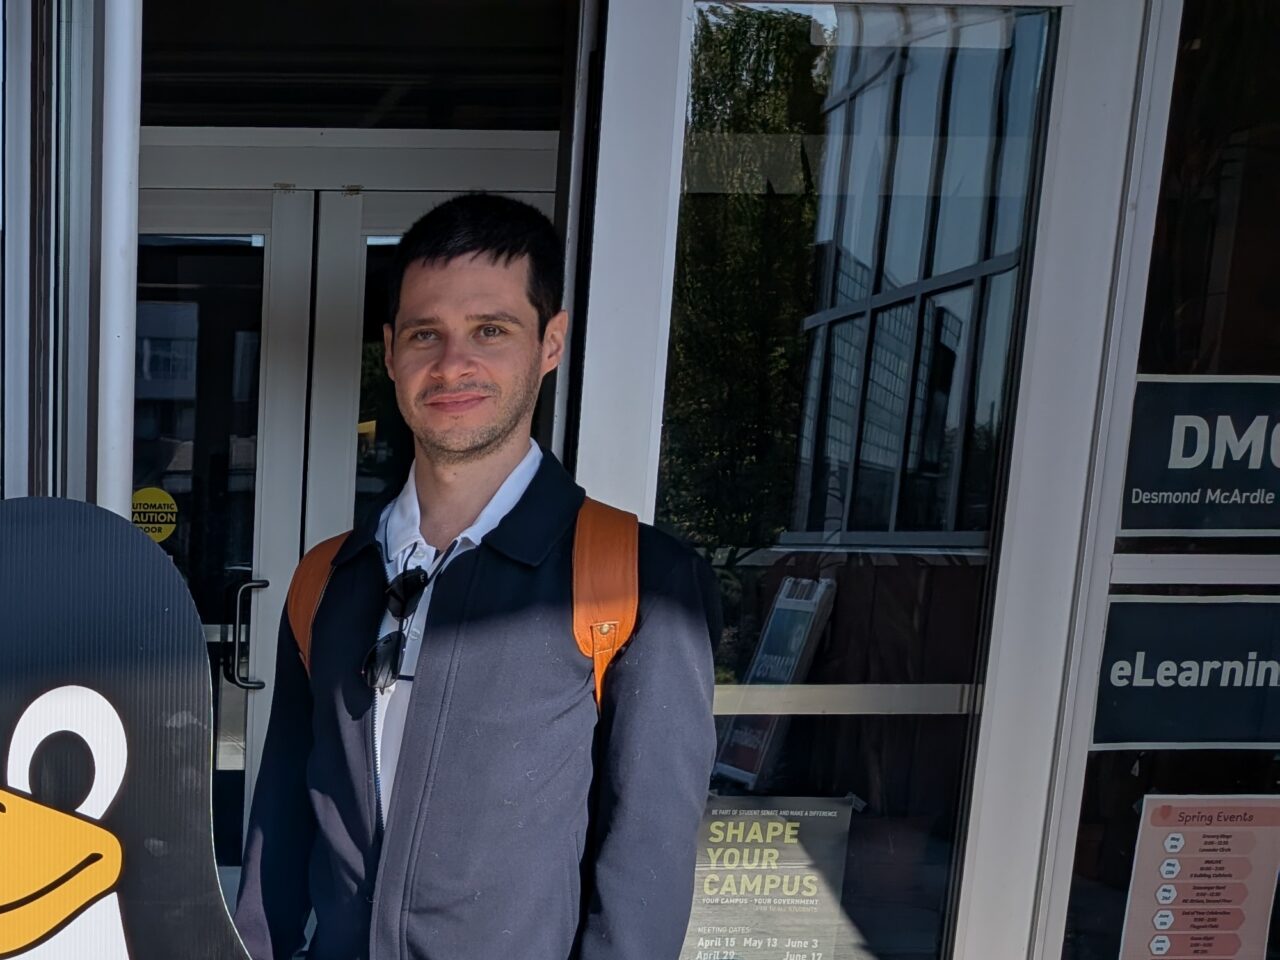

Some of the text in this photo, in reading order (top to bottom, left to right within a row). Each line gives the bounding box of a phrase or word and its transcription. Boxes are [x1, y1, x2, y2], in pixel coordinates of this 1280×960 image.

[1168, 415, 1280, 469] DM
[1131, 488, 1275, 504] Desmond McArdle
[133, 513, 176, 522] AUTION
[1110, 652, 1280, 687] eLearnin
[1178, 811, 1254, 825] Spring Events
[708, 821, 800, 844] SHAPE
[707, 848, 779, 869] YOUR
[704, 874, 818, 896] CAMPUS
[697, 926, 727, 934] MEETING
[697, 937, 736, 949] April 15
[743, 938, 778, 949] May 13
[785, 938, 818, 949] June 3
[722, 951, 735, 960] 29
